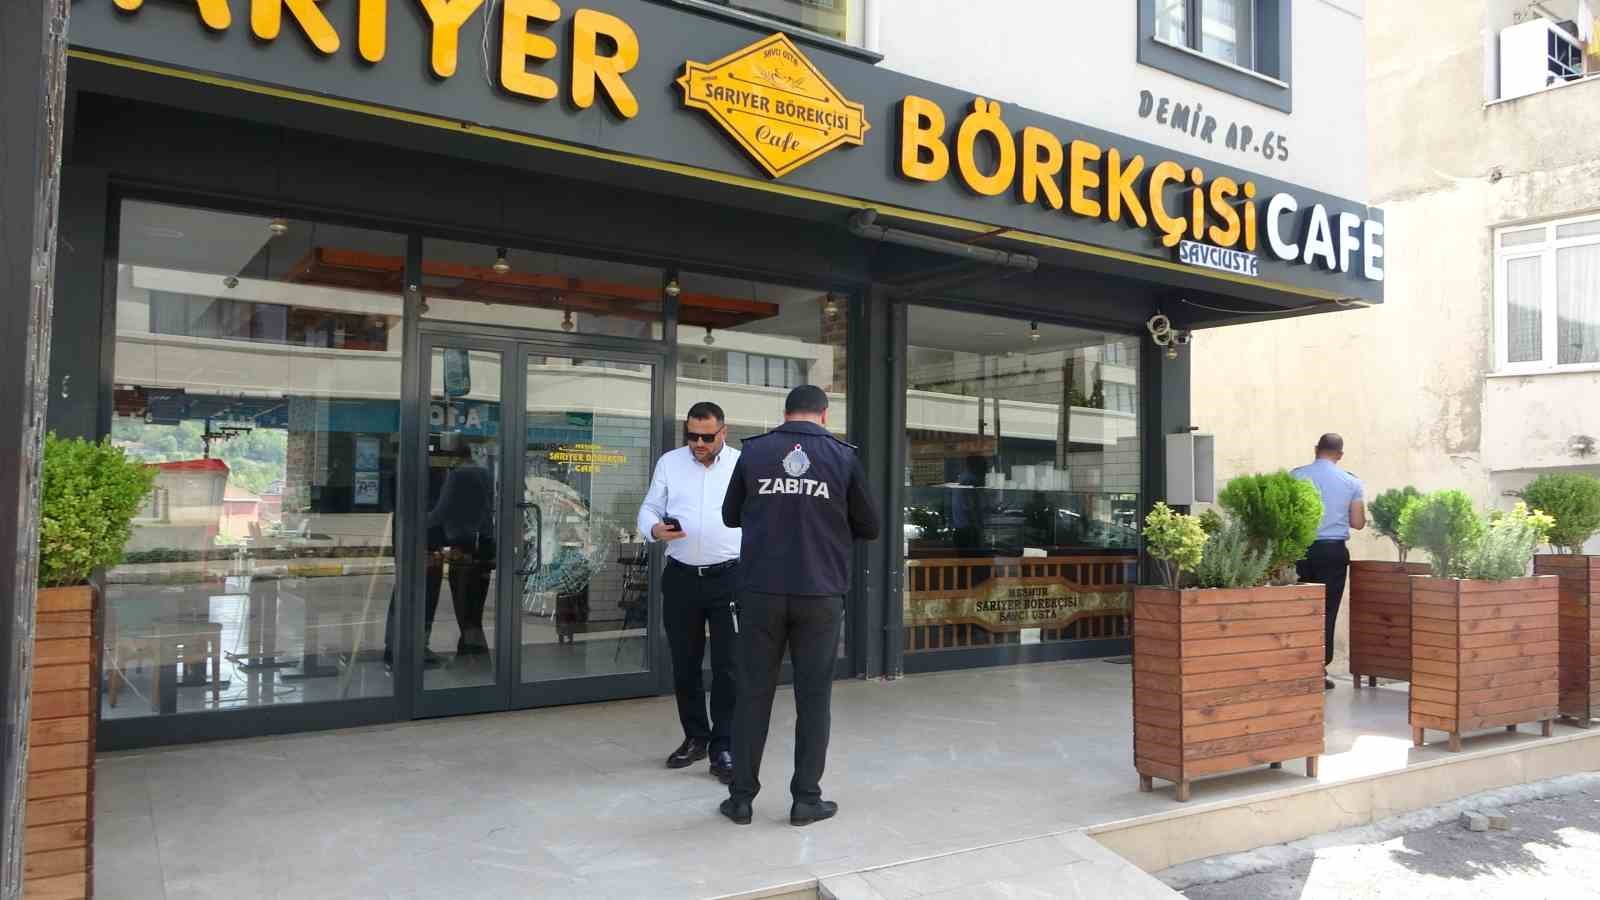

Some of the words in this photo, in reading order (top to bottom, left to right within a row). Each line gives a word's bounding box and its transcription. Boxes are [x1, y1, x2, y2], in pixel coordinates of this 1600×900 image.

[705, 83, 770, 114] SARIYER
[775, 100, 849, 131] BÖREKÇİSİ
[1138, 89, 1217, 144] DEMİR
[755, 124, 800, 152] Cafe
[901, 95, 1256, 251] BÖREKÇİSİ
[1266, 192, 1385, 281] CAFE
[758, 478, 830, 498] ZABITA
